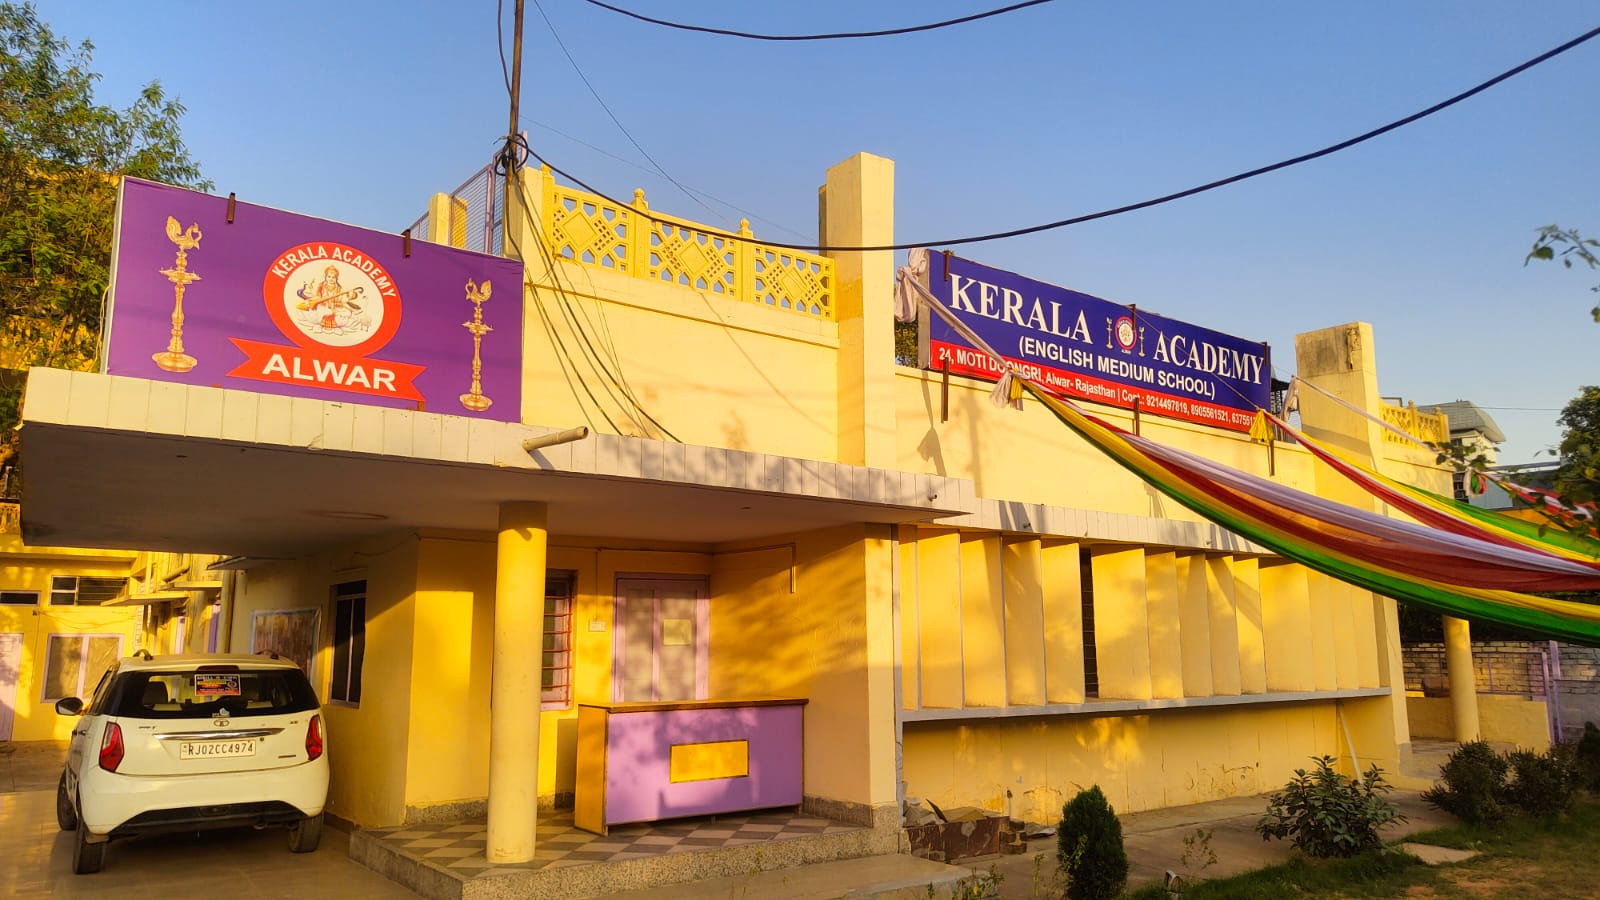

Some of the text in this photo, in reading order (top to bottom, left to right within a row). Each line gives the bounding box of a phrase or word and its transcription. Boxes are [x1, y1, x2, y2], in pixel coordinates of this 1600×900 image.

[272, 245, 397, 298] KERALA ACADEMY
[949, 273, 1265, 384] KERALA ACADEMY
[262, 353, 396, 391] ALWAR
[939, 347, 954, 364] 24,
[956, 349, 986, 370] MOTI
[1046, 372, 1074, 388] Alwar-
[1075, 378, 1116, 399] Rajasthan
[1231, 412, 1256, 427] 637551
[1019, 335, 1216, 401] (ENGLISH MEDIUM SCHOOL)
[188, 742, 254, 756] RJ02CC4974
